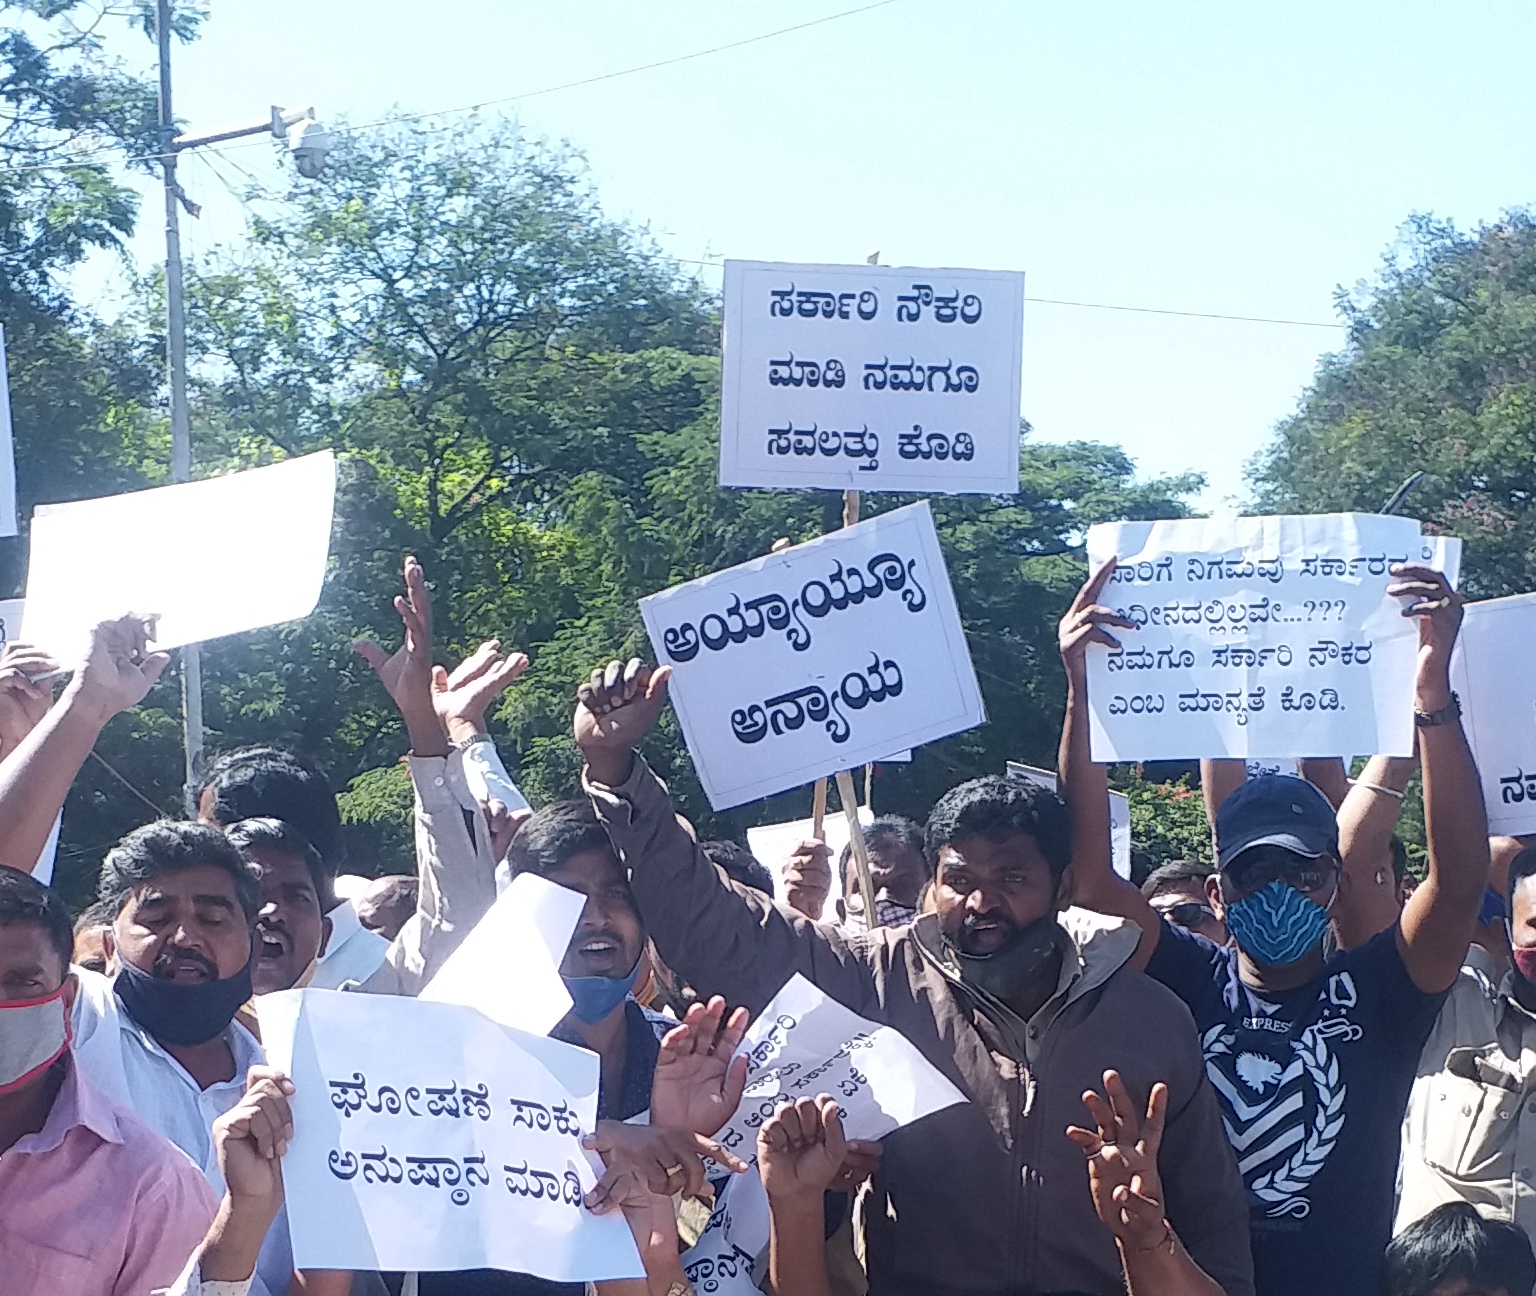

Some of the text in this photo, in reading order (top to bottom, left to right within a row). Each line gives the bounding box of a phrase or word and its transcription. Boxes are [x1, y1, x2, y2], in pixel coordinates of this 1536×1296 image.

[770, 281, 983, 325] ಸರ್ಕಾರಿ ನೌಕರಿ
[768, 350, 980, 393] ಮಾಡಿ ನಮಗೂ
[767, 420, 975, 472] ಸವಲತ್ತು ಕೊಡಿ
[1109, 556, 1173, 584] ಸಾರಿಗೆ
[1187, 553, 1284, 584] ನಿಗಮವು
[1107, 640, 1373, 672] ನಮಗೂ ಸರ್ಕಾರಿ ನೌಕರ
[731, 651, 904, 745] ಅನ್ಯಾಯ
[1109, 686, 1346, 727] ಎಂಬ ಮಾನ್ಯತೆ ಕೊಡಿ.
[329, 1072, 581, 1137] ಘೋಷಣೆ ಸಾಕು
[328, 1145, 583, 1208] ಅನುಷ್ಠಾನ ಮಾಡಿ
